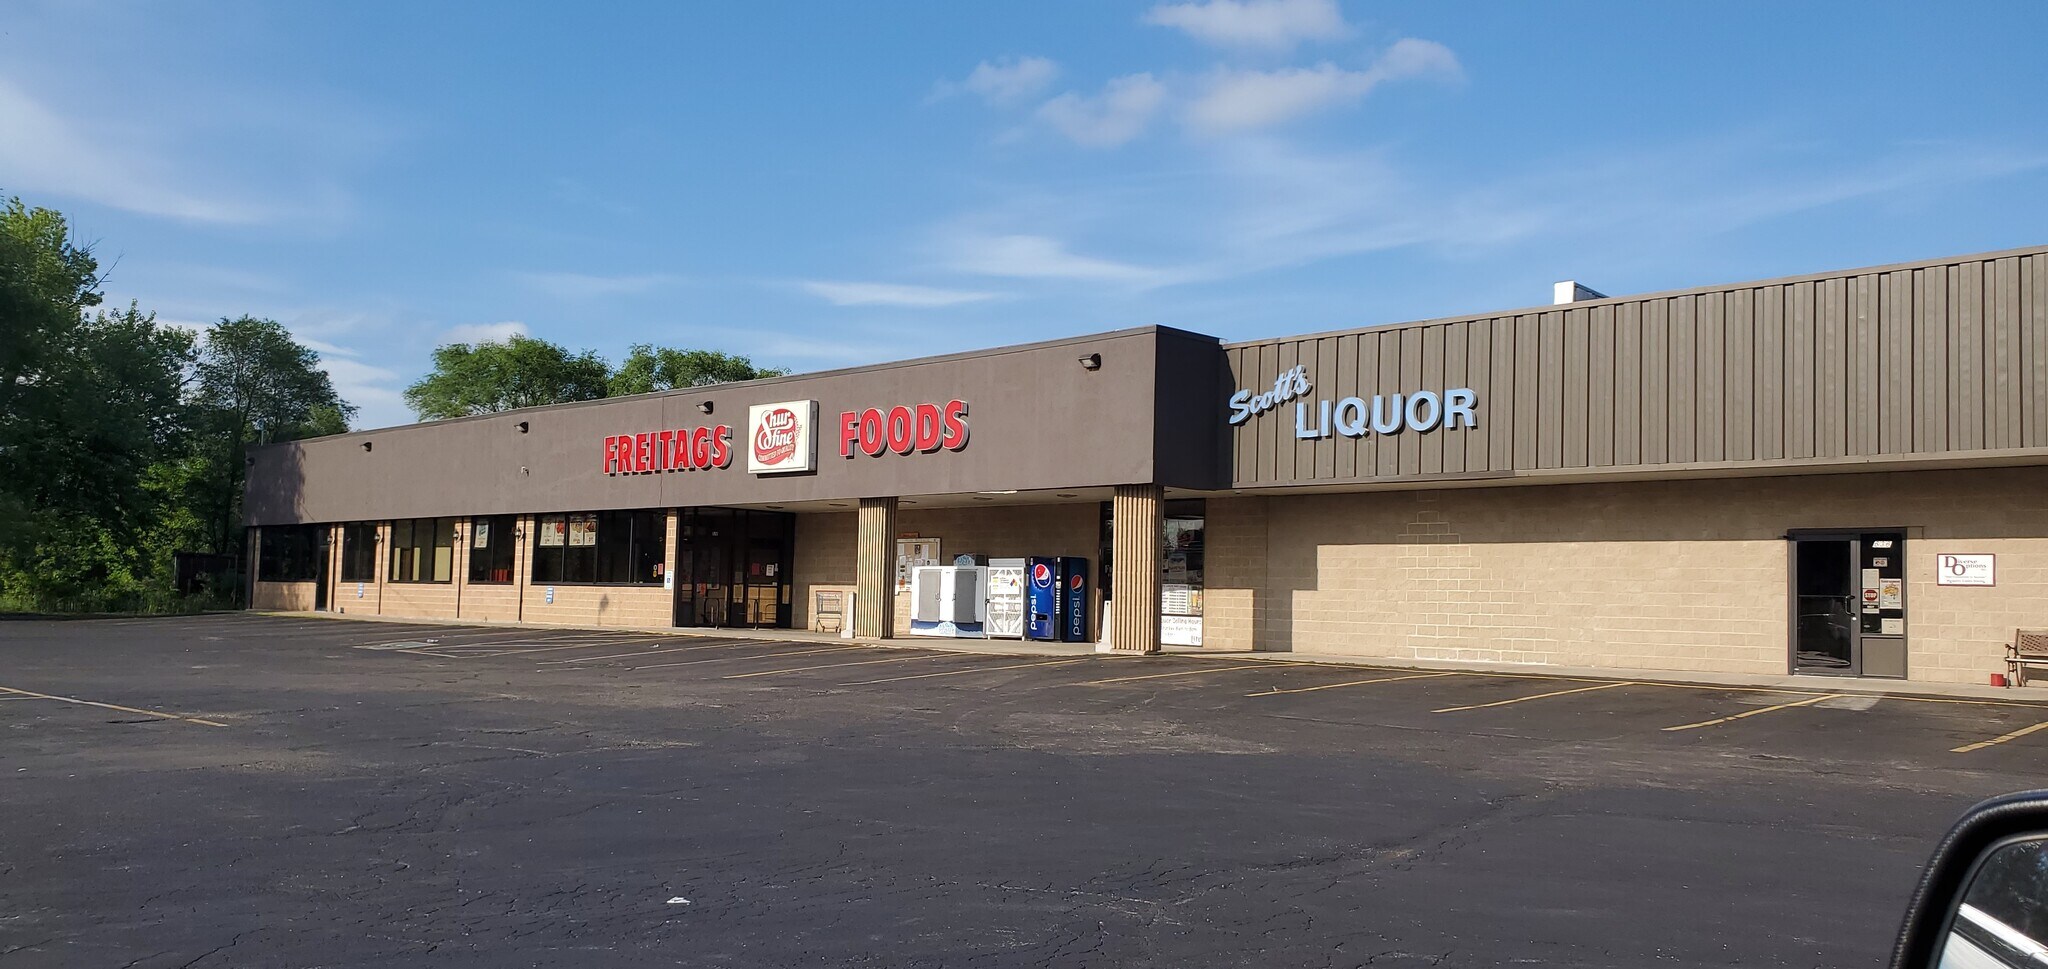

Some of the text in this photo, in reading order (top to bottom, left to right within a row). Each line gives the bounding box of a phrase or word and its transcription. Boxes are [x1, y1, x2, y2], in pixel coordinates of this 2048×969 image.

[1228, 364, 1312, 426] Scott's
[1296, 388, 1478, 440] LIQUOR
[759, 410, 793, 436] Shur
[839, 400, 968, 458] FOODS
[602, 425, 731, 475] FREITAGS
[1944, 556, 1978, 568] Diverse
[1952, 563, 1987, 576] Options
[1030, 594, 1038, 630] pepsi
[1072, 596, 1082, 636] pepsi
